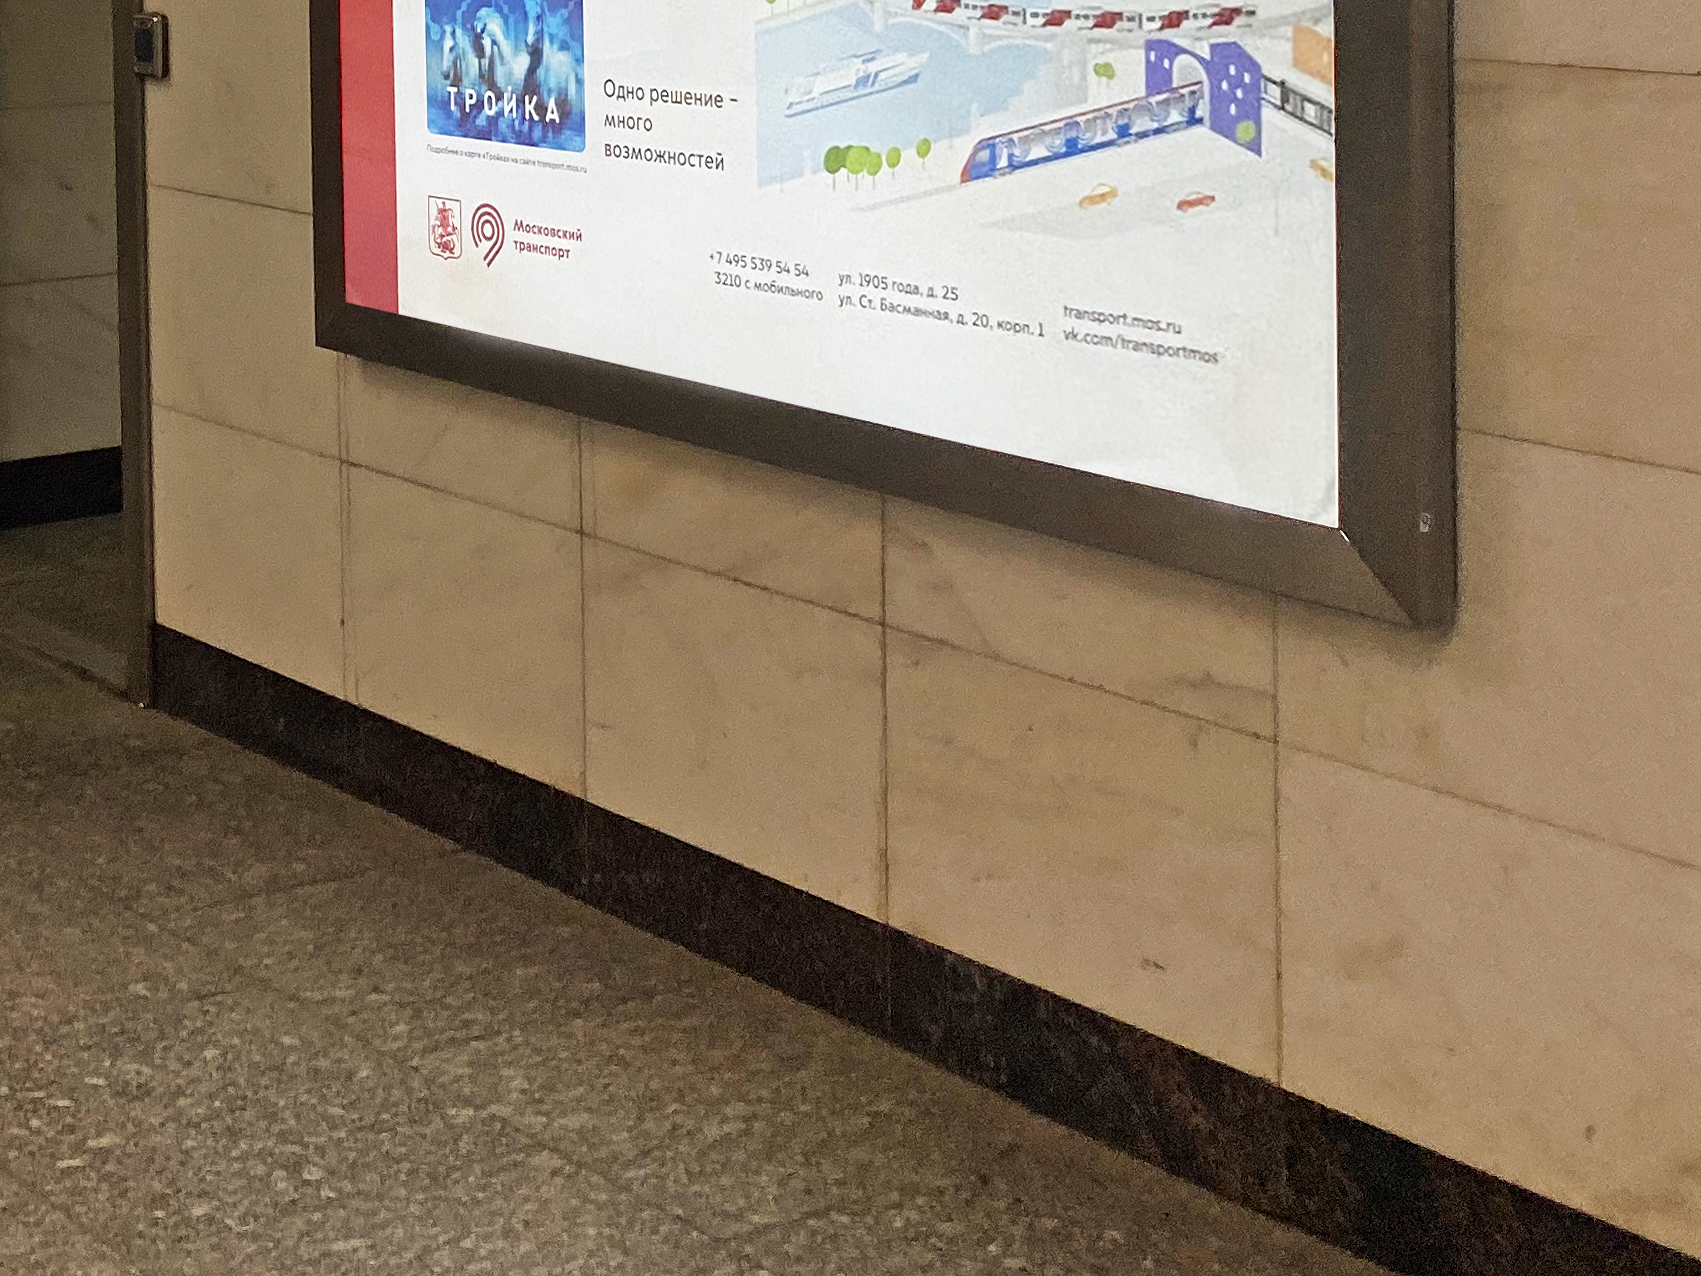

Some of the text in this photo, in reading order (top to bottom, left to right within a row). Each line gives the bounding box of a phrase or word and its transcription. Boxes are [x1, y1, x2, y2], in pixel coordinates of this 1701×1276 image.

[446, 85, 561, 124] ТРОЙКА
[603, 79, 645, 103] Одно
[649, 88, 724, 109] решение
[604, 112, 653, 133] много
[604, 141, 725, 172] возможностей
[513, 218, 583, 242] Московский
[513, 240, 571, 261] транспорт
[709, 250, 810, 278] +7 495 539 54 54
[714, 271, 824, 302] 3210 с мобильного
[838, 272, 959, 301] ул. 1905 года, д. 25
[838, 293, 855, 308] ул.
[858, 294, 876, 311] Ст.
[879, 297, 954, 324] Басманная,
[971, 311, 993, 331] 20,
[996, 318, 1035, 337] корп.
[1038, 321, 1045, 338] 1
[1063, 304, 1182, 335] transport.mos.ru
[1062, 327, 1220, 365] vk.com/transportmos
